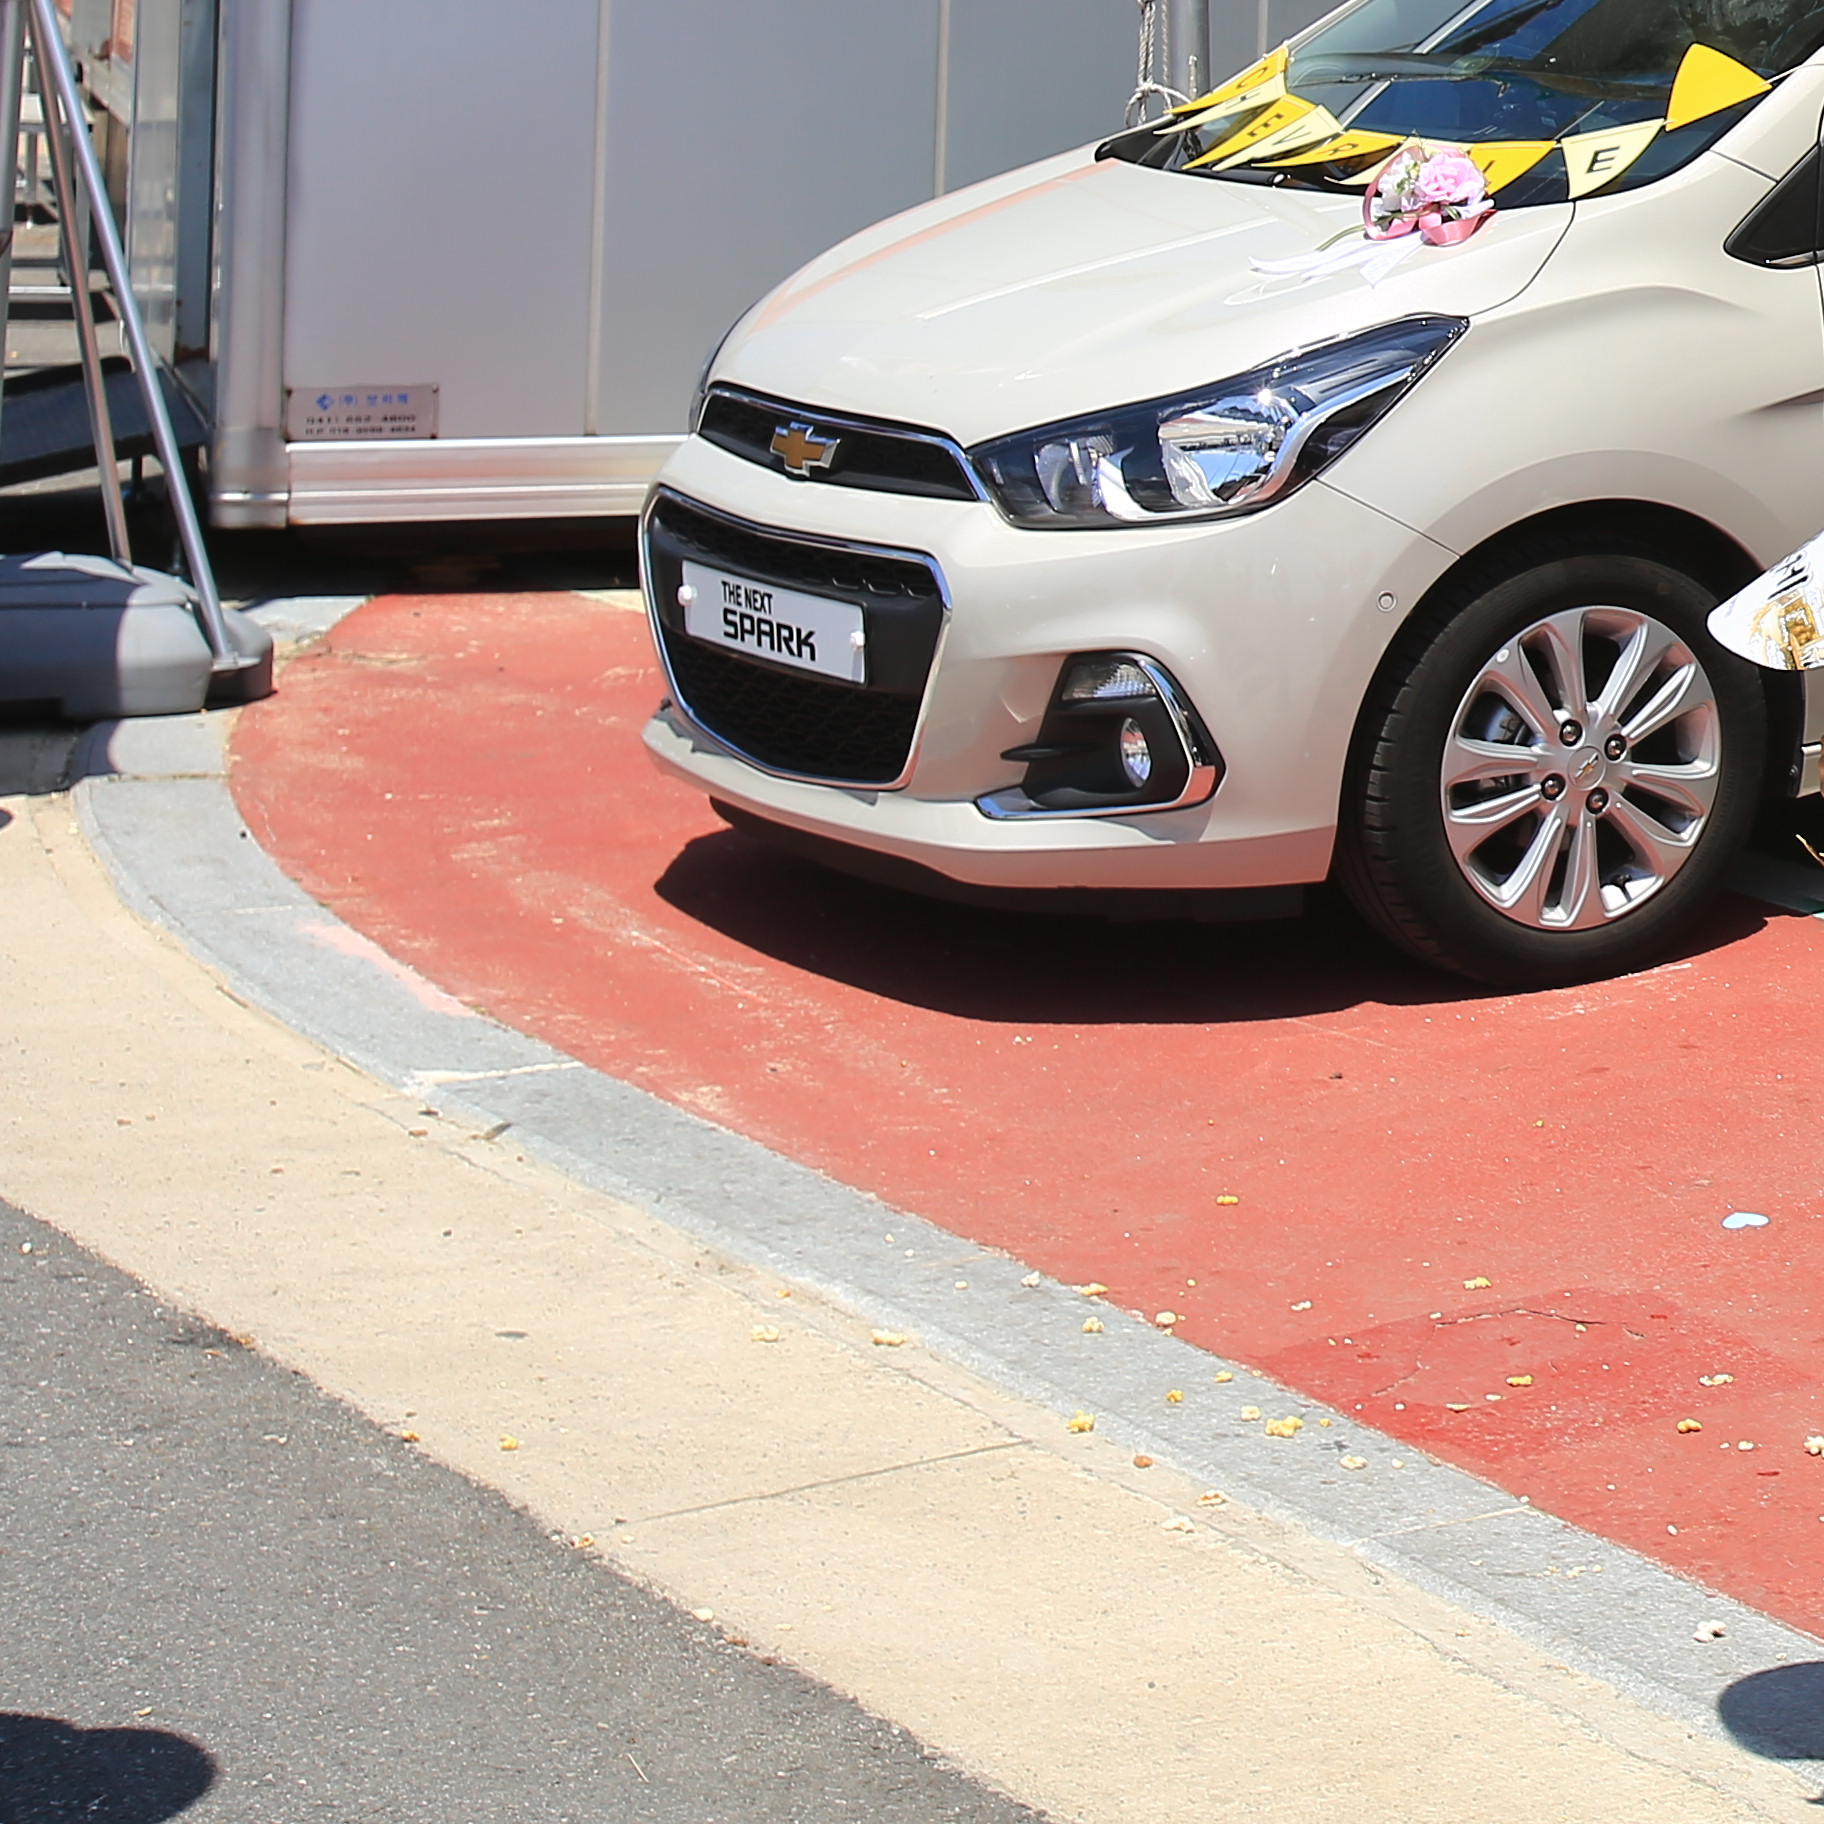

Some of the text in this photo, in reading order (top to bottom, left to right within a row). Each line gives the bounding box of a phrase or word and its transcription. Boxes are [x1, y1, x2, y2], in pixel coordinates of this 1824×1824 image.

[721, 580, 773, 615] THE NEXT
[722, 607, 817, 662] SPARK
